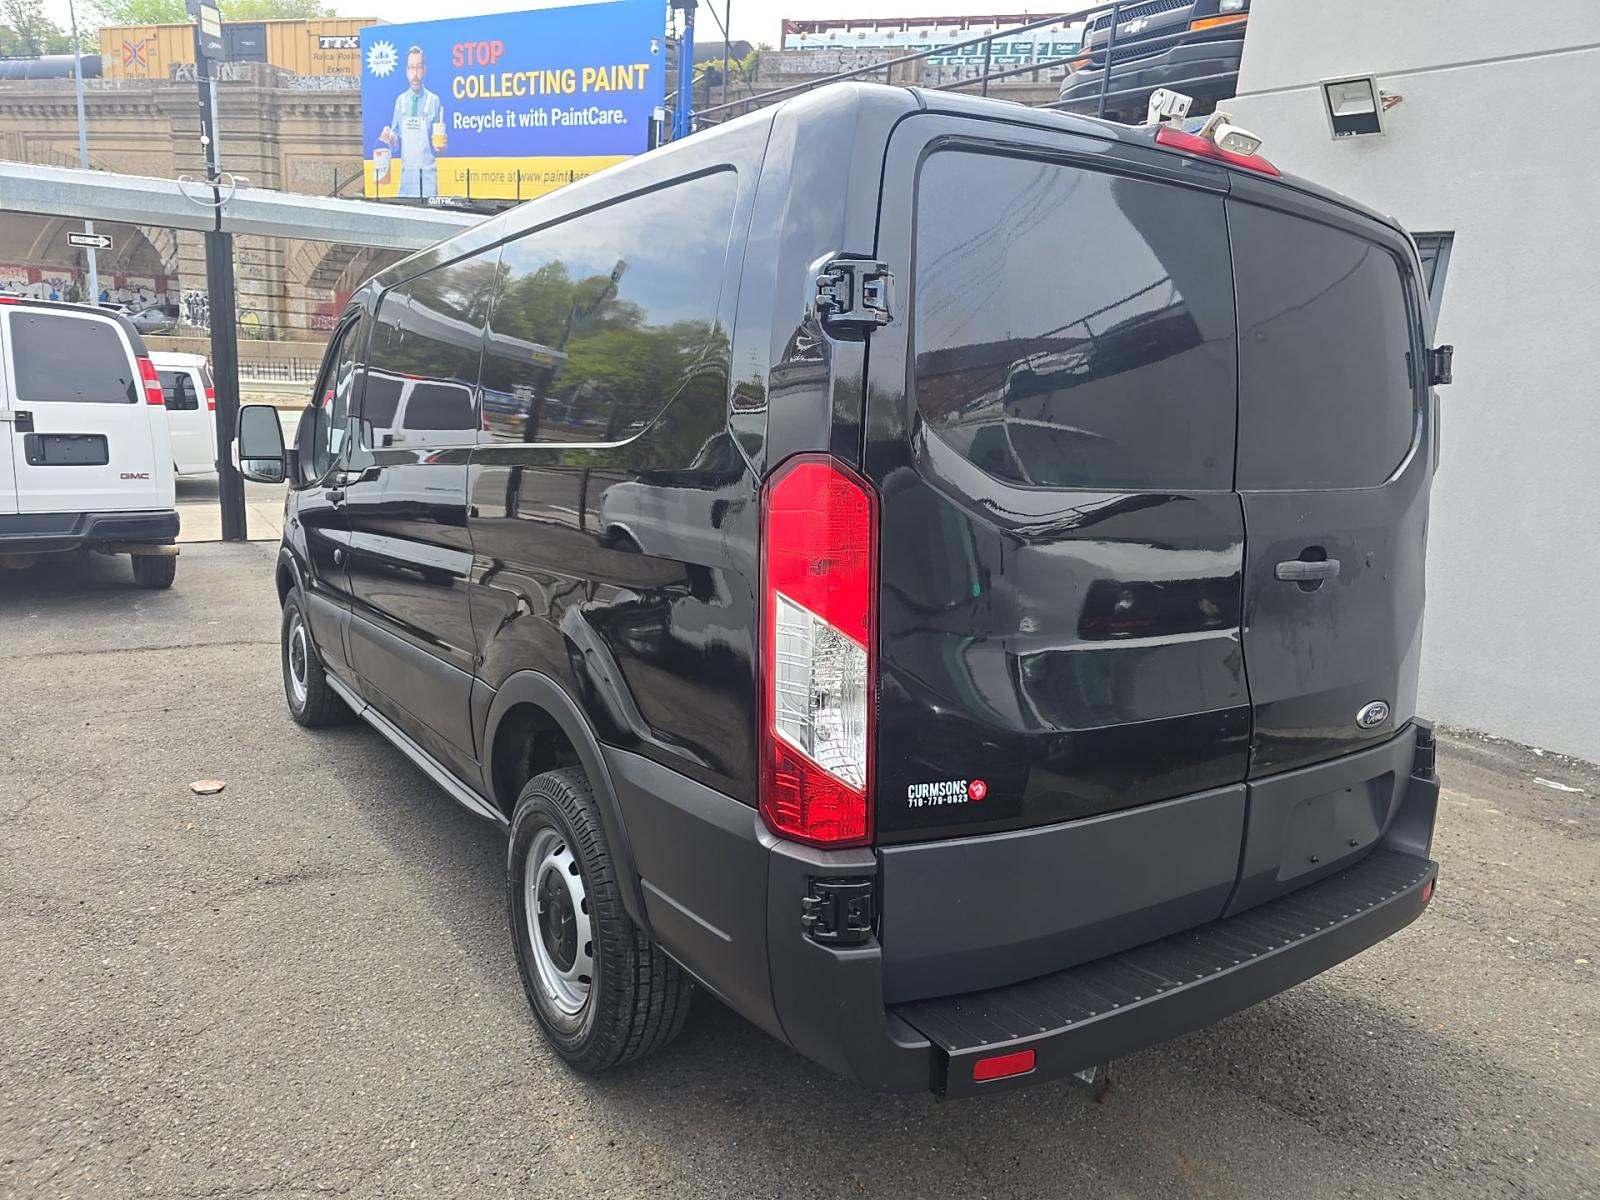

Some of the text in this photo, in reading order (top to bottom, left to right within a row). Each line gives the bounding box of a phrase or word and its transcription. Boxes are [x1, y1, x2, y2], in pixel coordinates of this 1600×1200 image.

[320, 36, 358, 48] TTX
[452, 40, 504, 68] STOP
[452, 63, 650, 100] COLLECTING PAINT
[453, 107, 627, 133] Recycle it with PaintCare.
[481, 171, 505, 182] more
[120, 472, 150, 480] GMC
